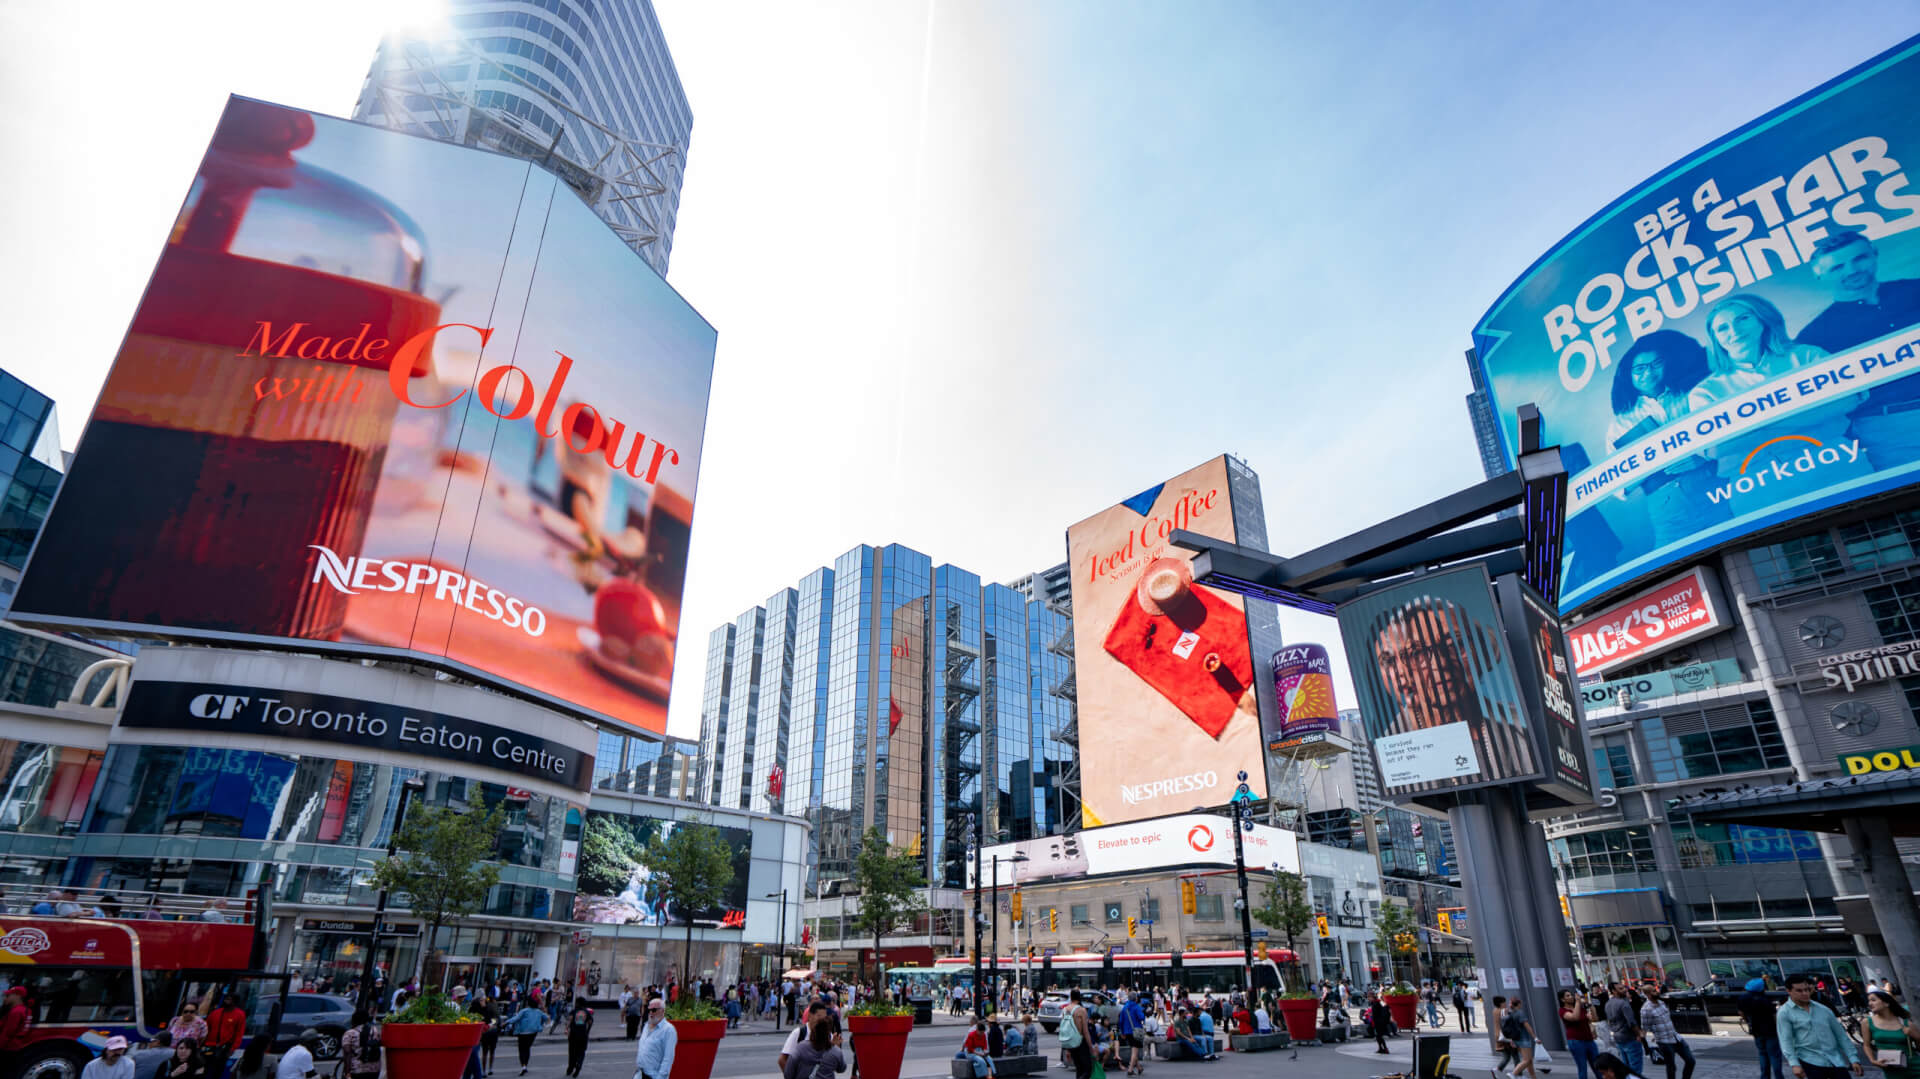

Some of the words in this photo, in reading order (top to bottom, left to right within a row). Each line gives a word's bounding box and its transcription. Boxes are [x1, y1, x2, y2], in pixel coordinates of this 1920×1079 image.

[1543, 221, 1705, 352] ROCK
[1706, 136, 1902, 251] STAR
[1634, 198, 1687, 245] BE
[1692, 178, 1722, 213] A
[1558, 315, 1618, 393] OF
[1623, 172, 1920, 342] BUSINESS
[235, 322, 388, 361] Made
[253, 363, 365, 404] with
[388, 322, 679, 486] Colour
[1575, 456, 1641, 500] FINANCE
[1644, 444, 1656, 462] &
[1663, 430, 1691, 455] HR
[1696, 411, 1732, 437] ON
[1736, 387, 1791, 418] ONE
[1800, 364, 1855, 397] EPIC
[1706, 438, 1861, 504] workday
[1088, 529, 1134, 585] Iced
[1140, 489, 1217, 549] Coffee
[308, 545, 546, 637] NESPRESSO
[1660, 587, 1693, 610] PARTY
[1664, 602, 1690, 620] THIS
[1667, 612, 1691, 630] WAY
[1572, 604, 1666, 669] JACK'S
[1818, 648, 1873, 667] LOUNGE
[189, 693, 250, 720] CF
[258, 697, 388, 737] Toronto
[399, 716, 483, 753] Eaton
[492, 735, 567, 775] Centre
[1121, 771, 1218, 805] NESPRESSO
[1098, 838, 1128, 849] Elevate
[1130, 836, 1140, 845] to
[1142, 832, 1161, 844] epic
